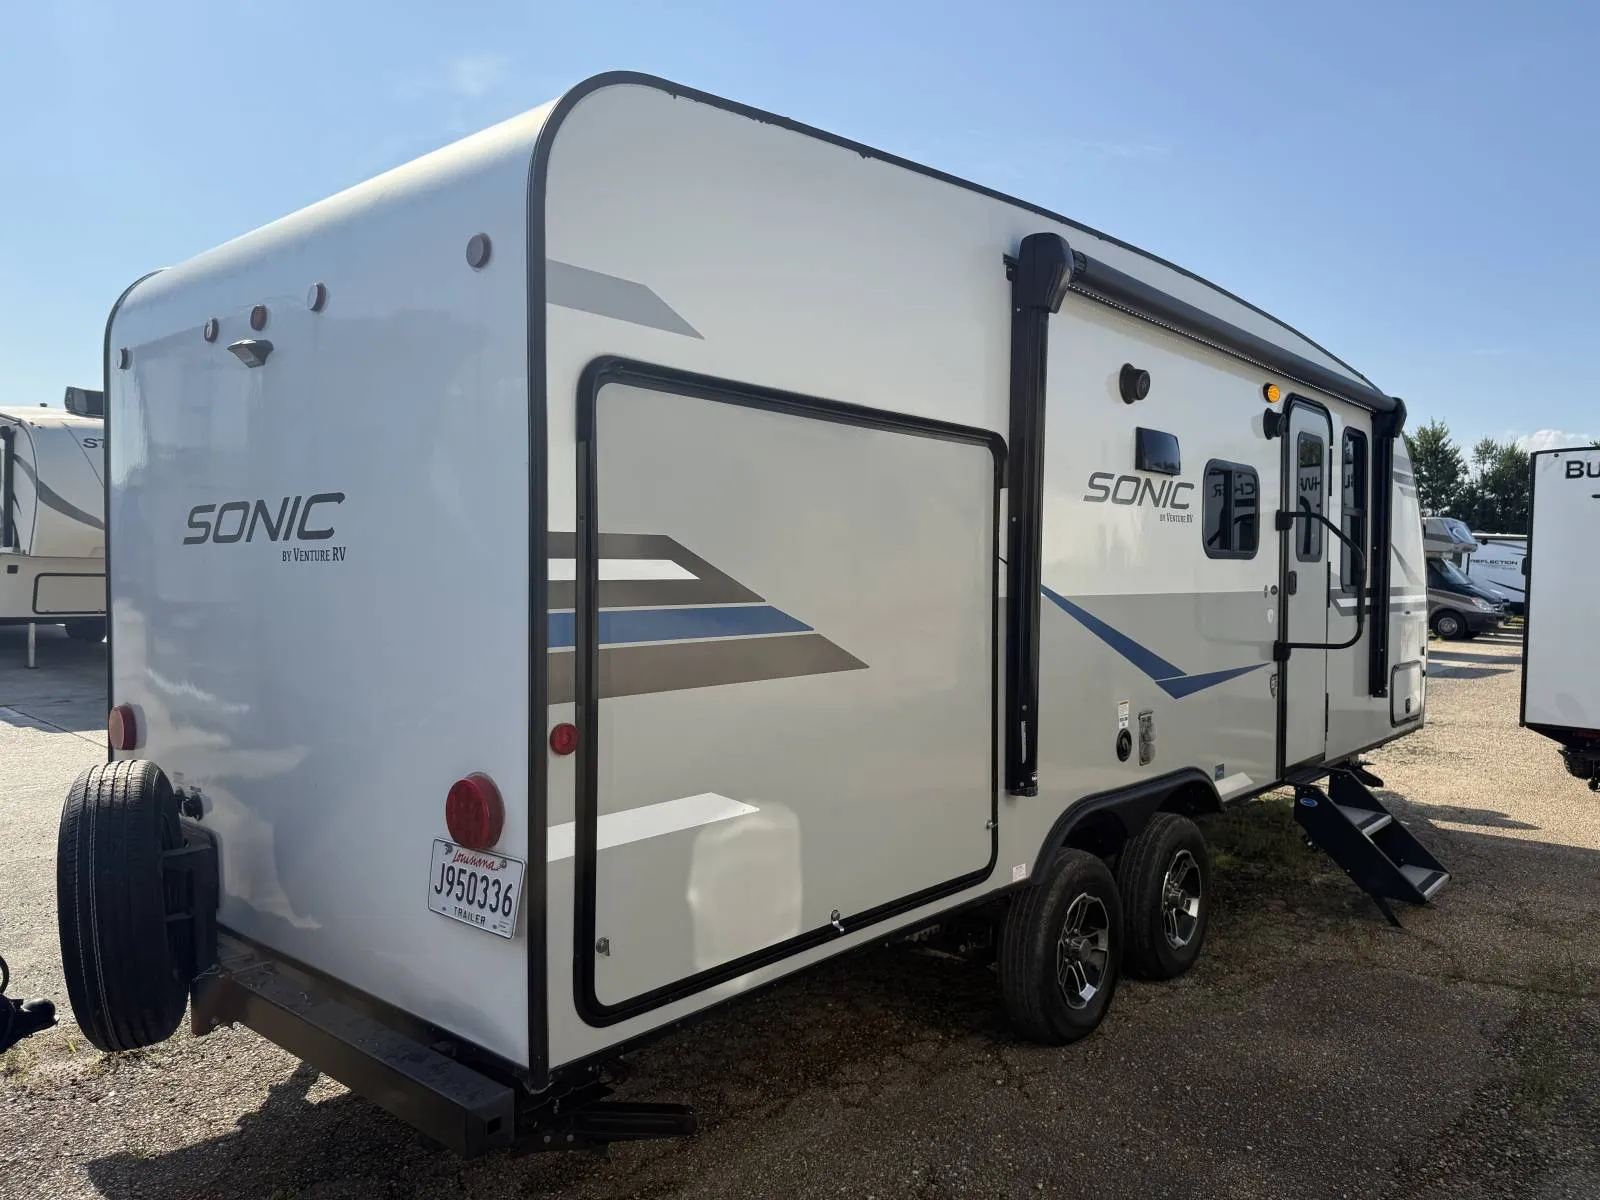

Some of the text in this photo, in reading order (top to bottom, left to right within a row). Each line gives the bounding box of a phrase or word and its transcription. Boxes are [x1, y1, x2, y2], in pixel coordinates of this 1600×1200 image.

[1565, 460, 1600, 479] BU
[1083, 471, 1195, 510] SONIC
[182, 491, 346, 546] SONIC
[282, 550, 292, 562] BY
[332, 546, 346, 562] RV
[434, 862, 513, 918] J950336
[454, 906, 486, 925] TRAILER
